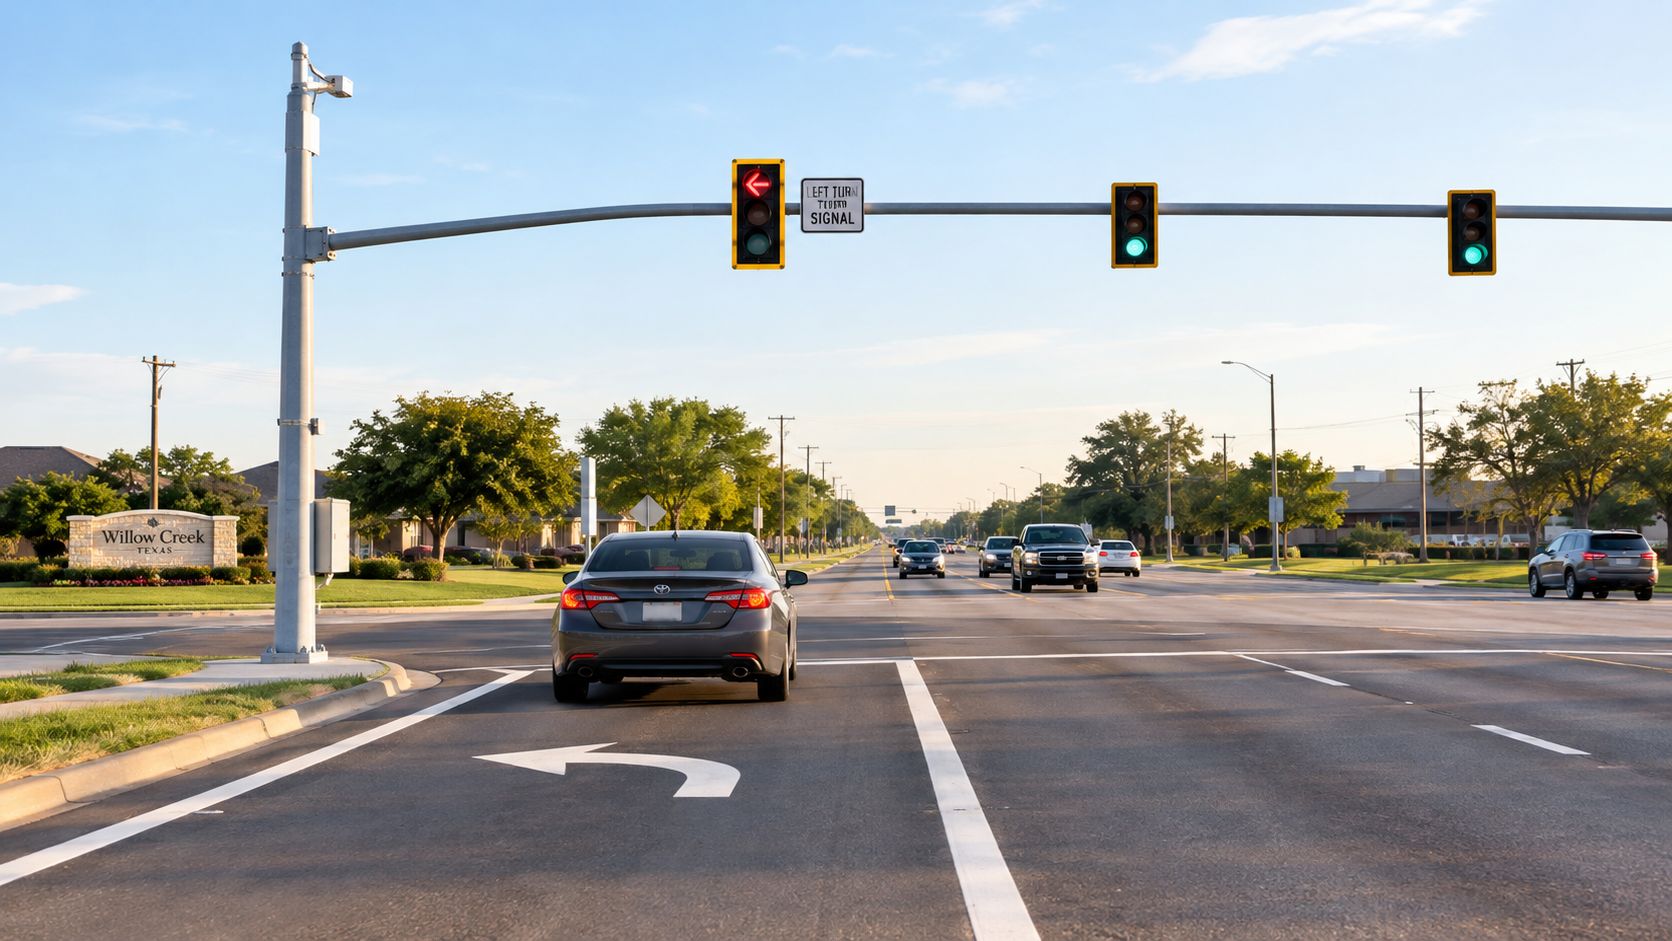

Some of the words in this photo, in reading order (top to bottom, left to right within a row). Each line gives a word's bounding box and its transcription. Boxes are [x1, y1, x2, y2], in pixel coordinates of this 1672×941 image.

[806, 186, 829, 198] LEFT
[811, 212, 855, 224] SIGNAL
[102, 530, 156, 544] Willow
[160, 530, 205, 544] Creek
